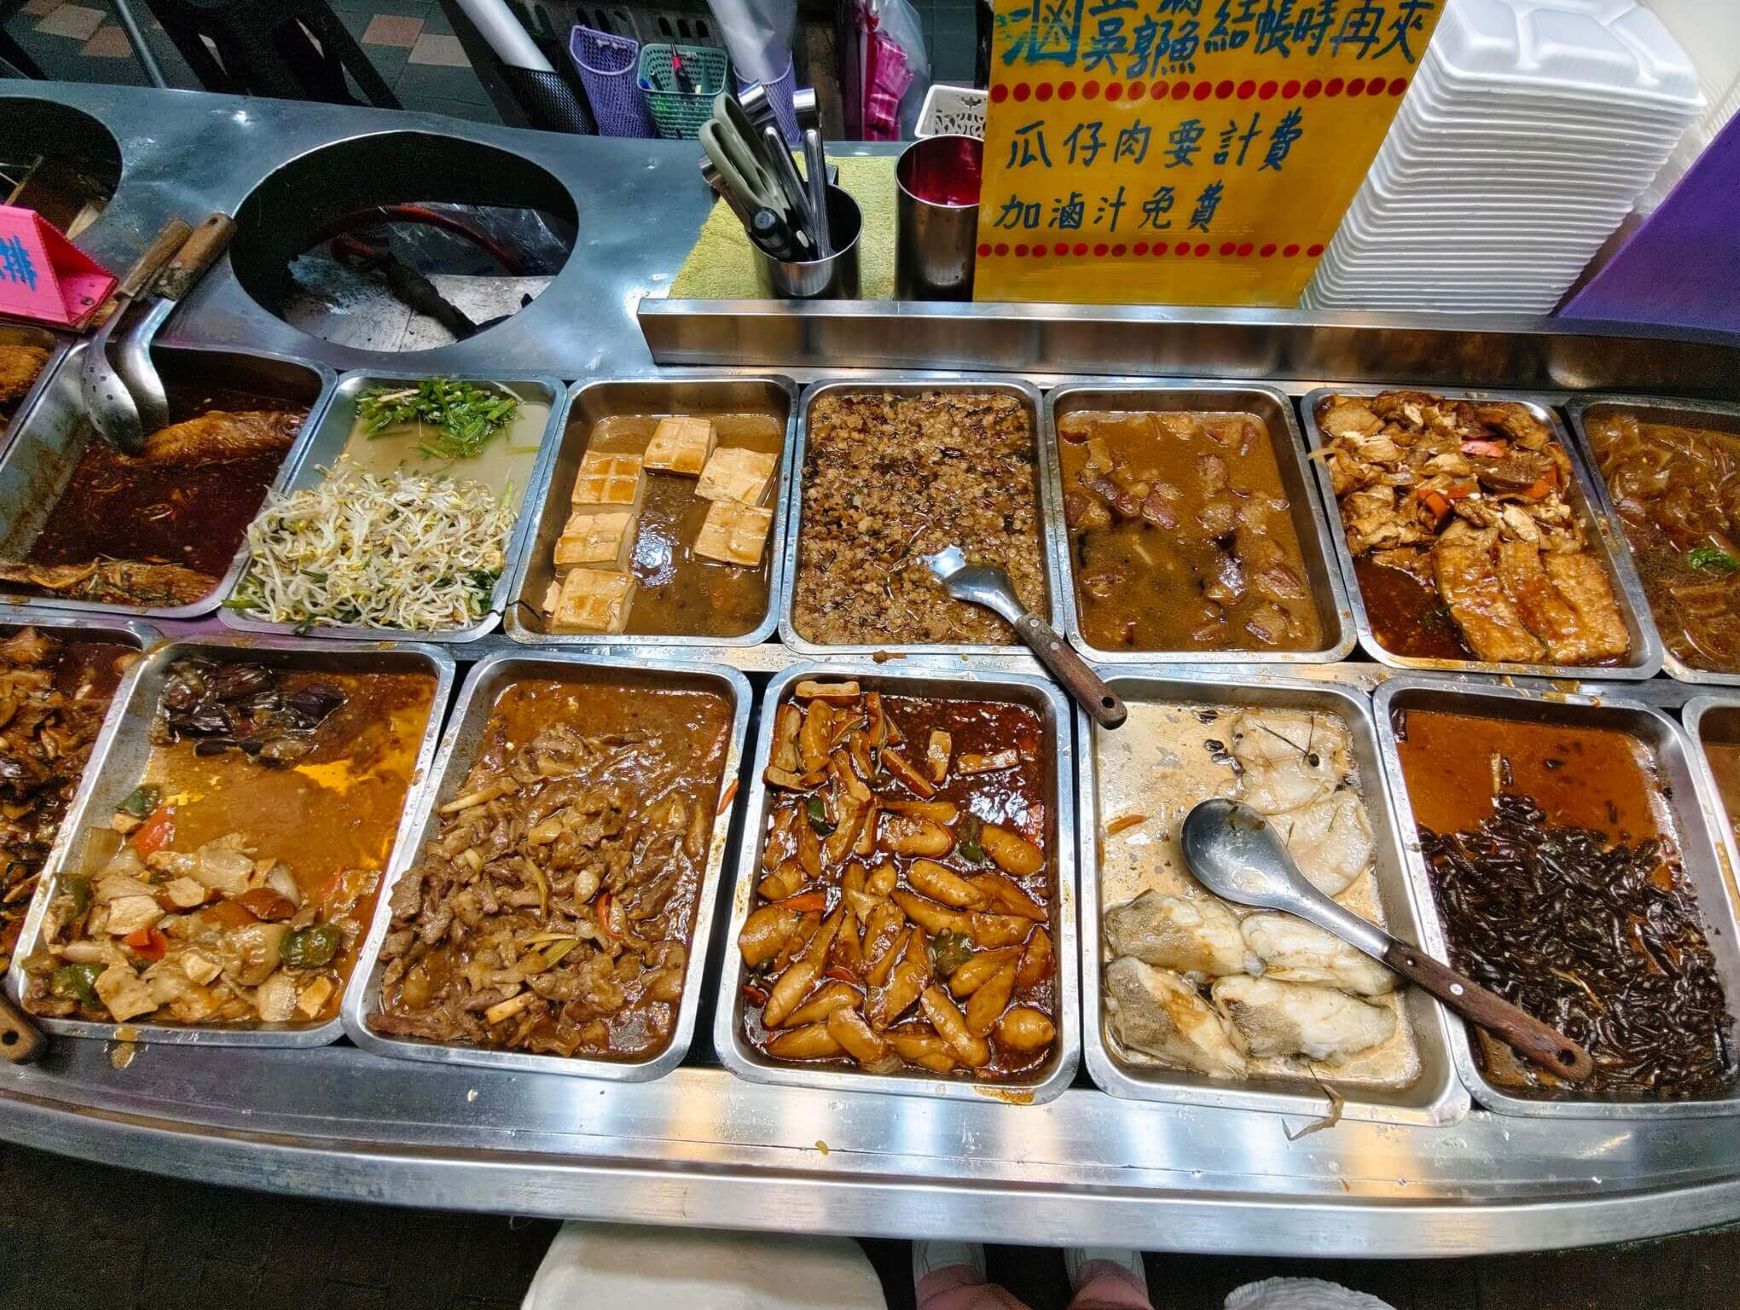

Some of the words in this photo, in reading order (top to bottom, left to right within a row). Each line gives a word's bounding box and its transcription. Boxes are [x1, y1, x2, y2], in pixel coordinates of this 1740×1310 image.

[1005, 107, 1304, 172] 瓜仔肉要計費
[993, 180, 1226, 233] 加滷汁免費
